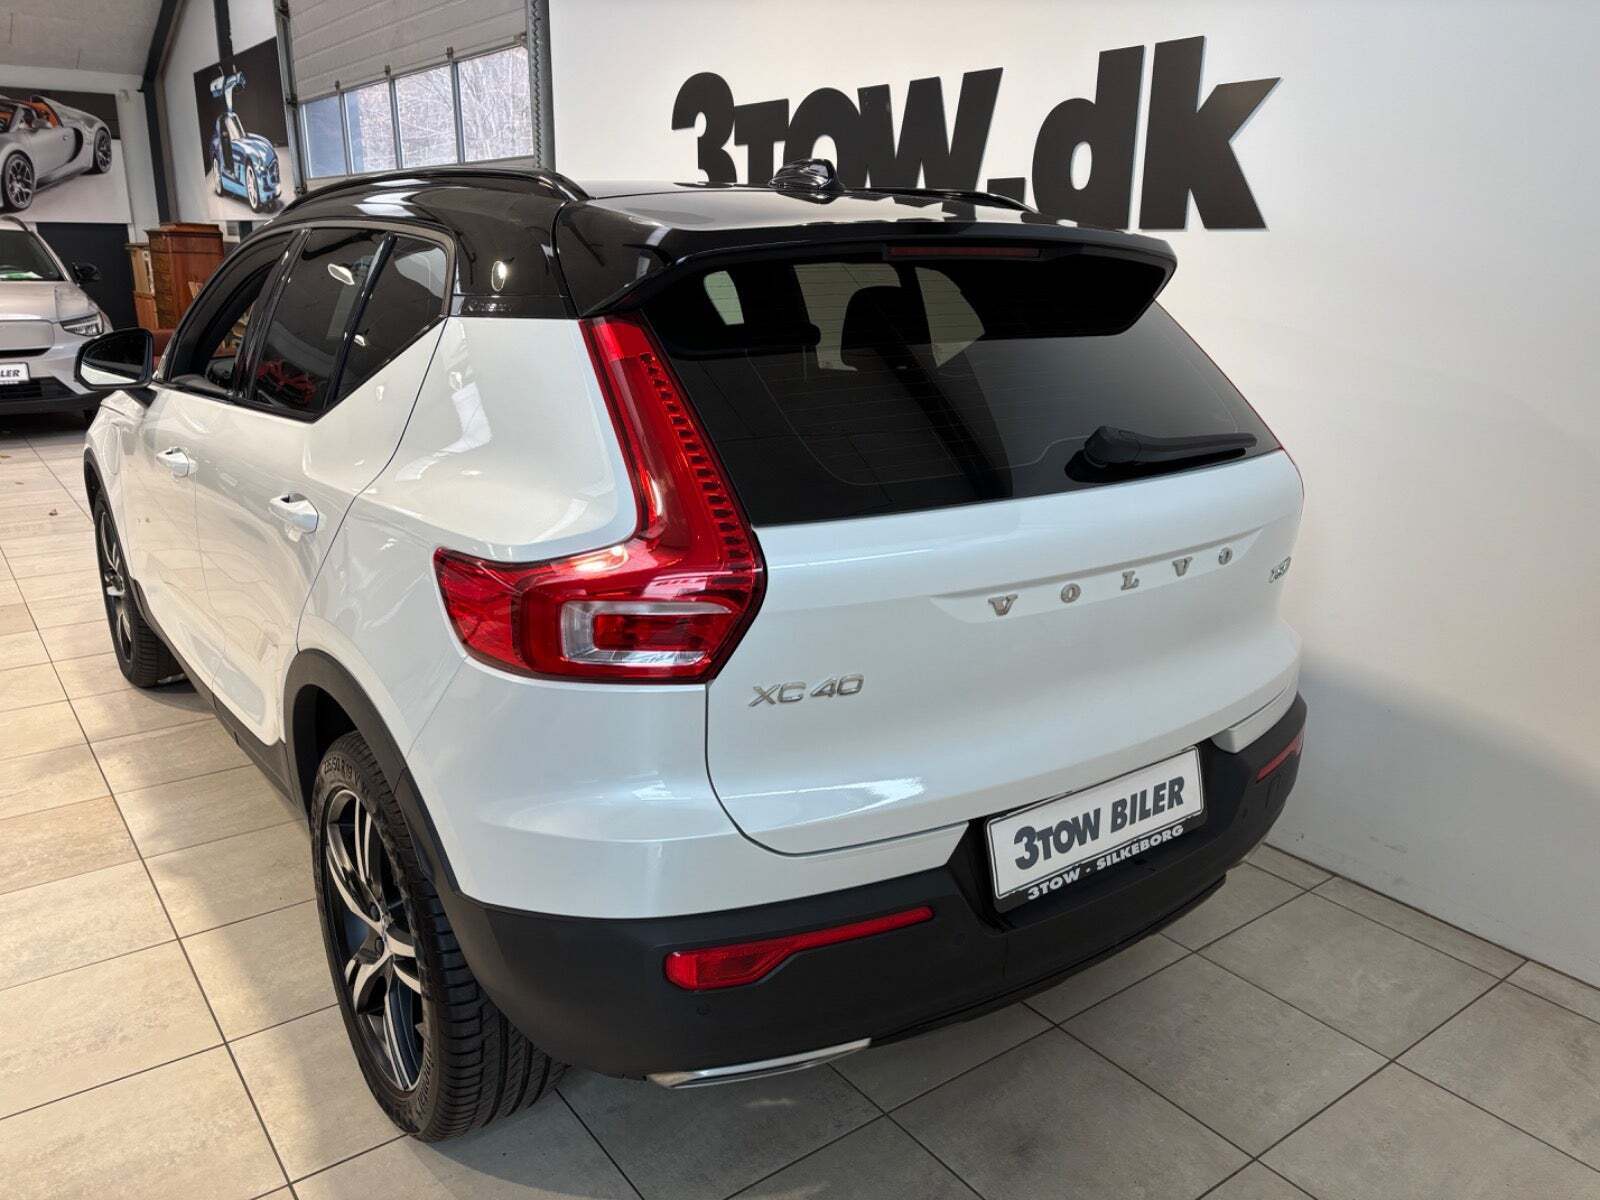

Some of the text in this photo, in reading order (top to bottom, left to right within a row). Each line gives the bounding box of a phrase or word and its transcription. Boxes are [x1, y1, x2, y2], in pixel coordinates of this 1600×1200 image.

[987, 546, 1234, 617] VOLVO
[1013, 776, 1185, 870] 3TOW BILER
[1027, 867, 1081, 900] 3TOW
[1096, 825, 1184, 871] SILKEBORG
